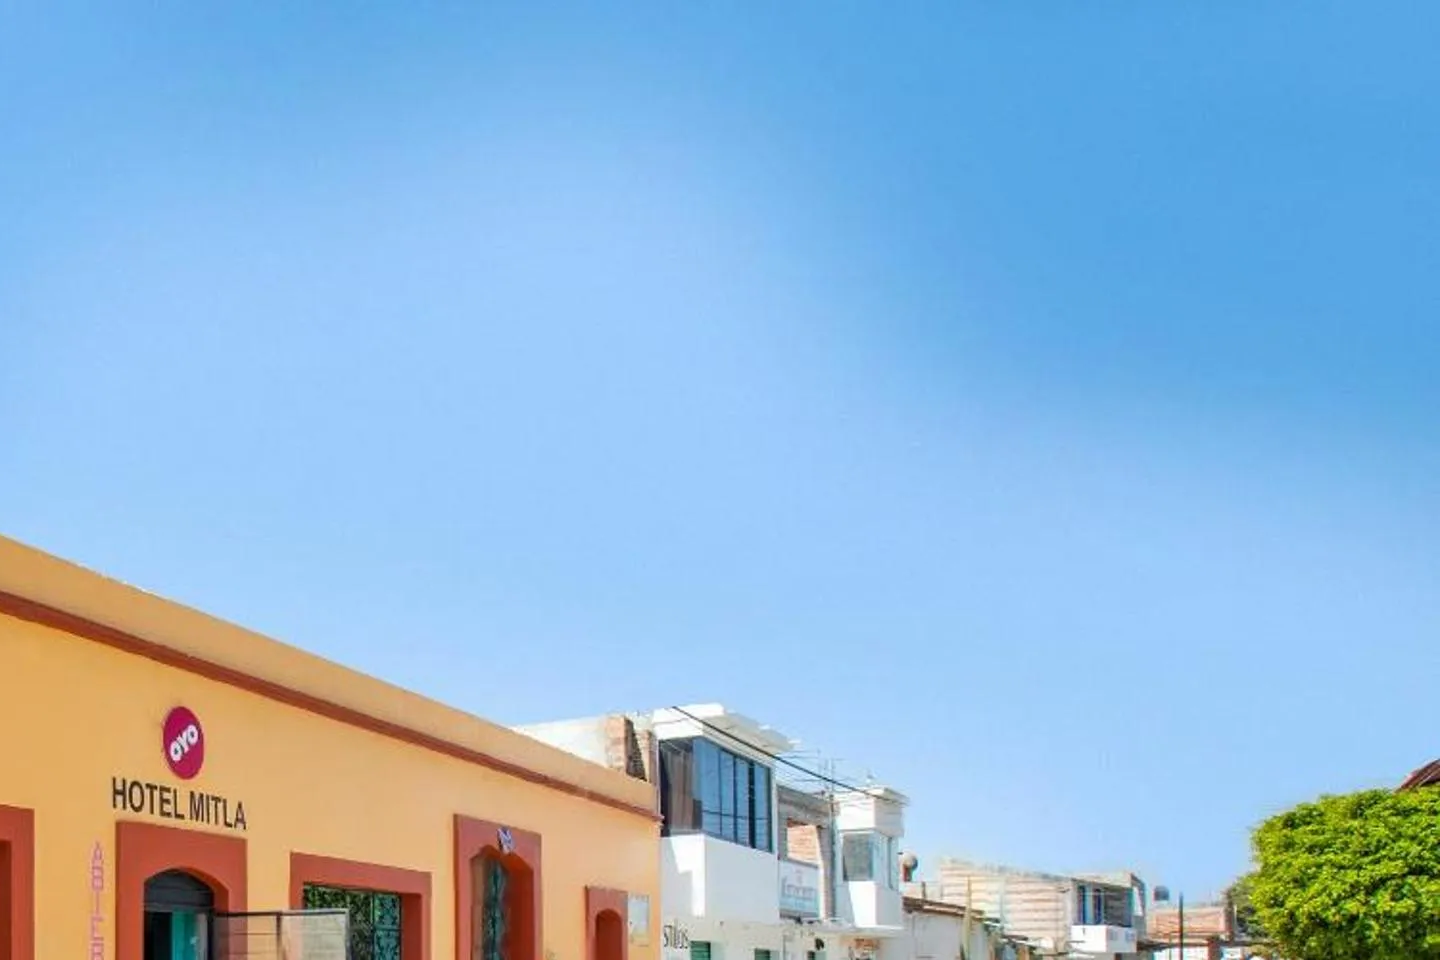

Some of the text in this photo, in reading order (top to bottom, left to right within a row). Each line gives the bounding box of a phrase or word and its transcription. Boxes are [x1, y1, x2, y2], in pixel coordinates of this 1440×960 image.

[170, 723, 199, 763] OYO
[111, 775, 247, 831] HOTEL MITLA
